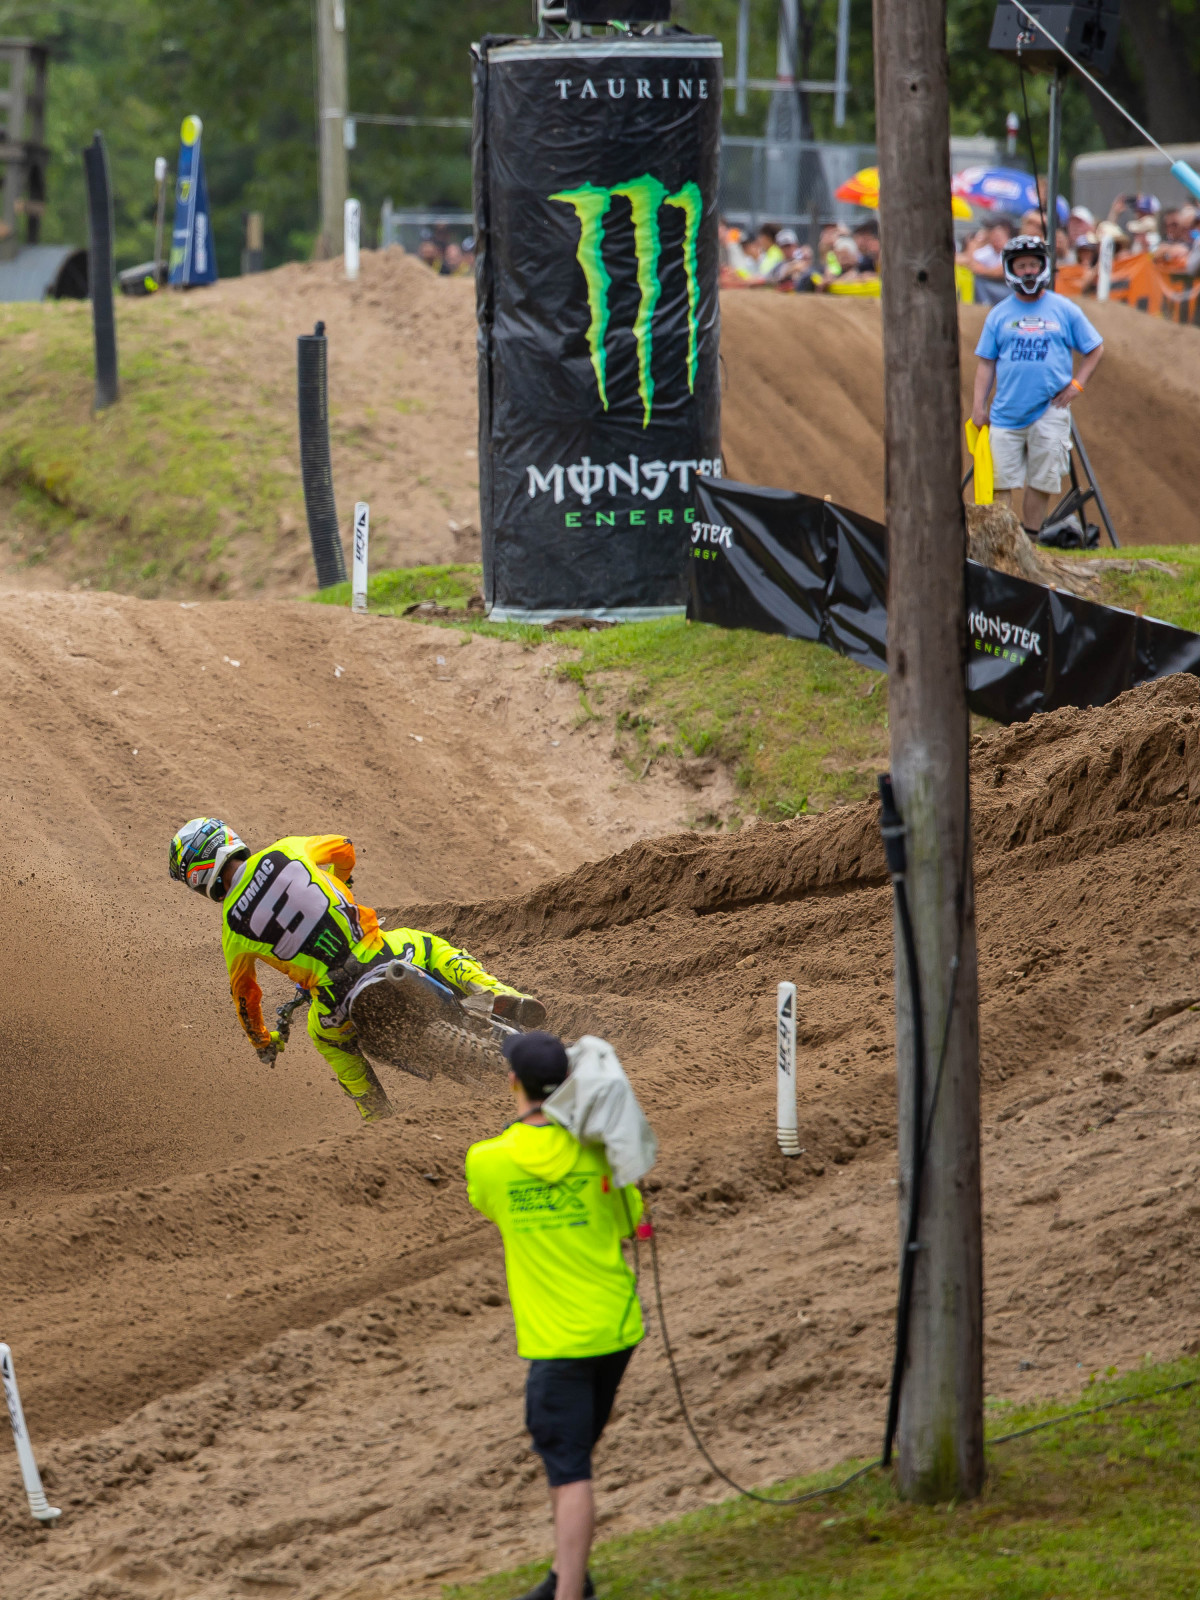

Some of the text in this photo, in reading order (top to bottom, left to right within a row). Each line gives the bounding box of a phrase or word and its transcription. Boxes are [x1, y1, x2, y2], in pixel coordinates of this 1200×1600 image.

[555, 78, 708, 100] TAURINE
[1011, 350, 1048, 362] CREW
[565, 507, 695, 528] ENERG
[691, 521, 732, 548] STER
[974, 639, 1026, 666] ENERGY
[231, 858, 275, 921] TOMAC
[249, 860, 329, 960] 3
